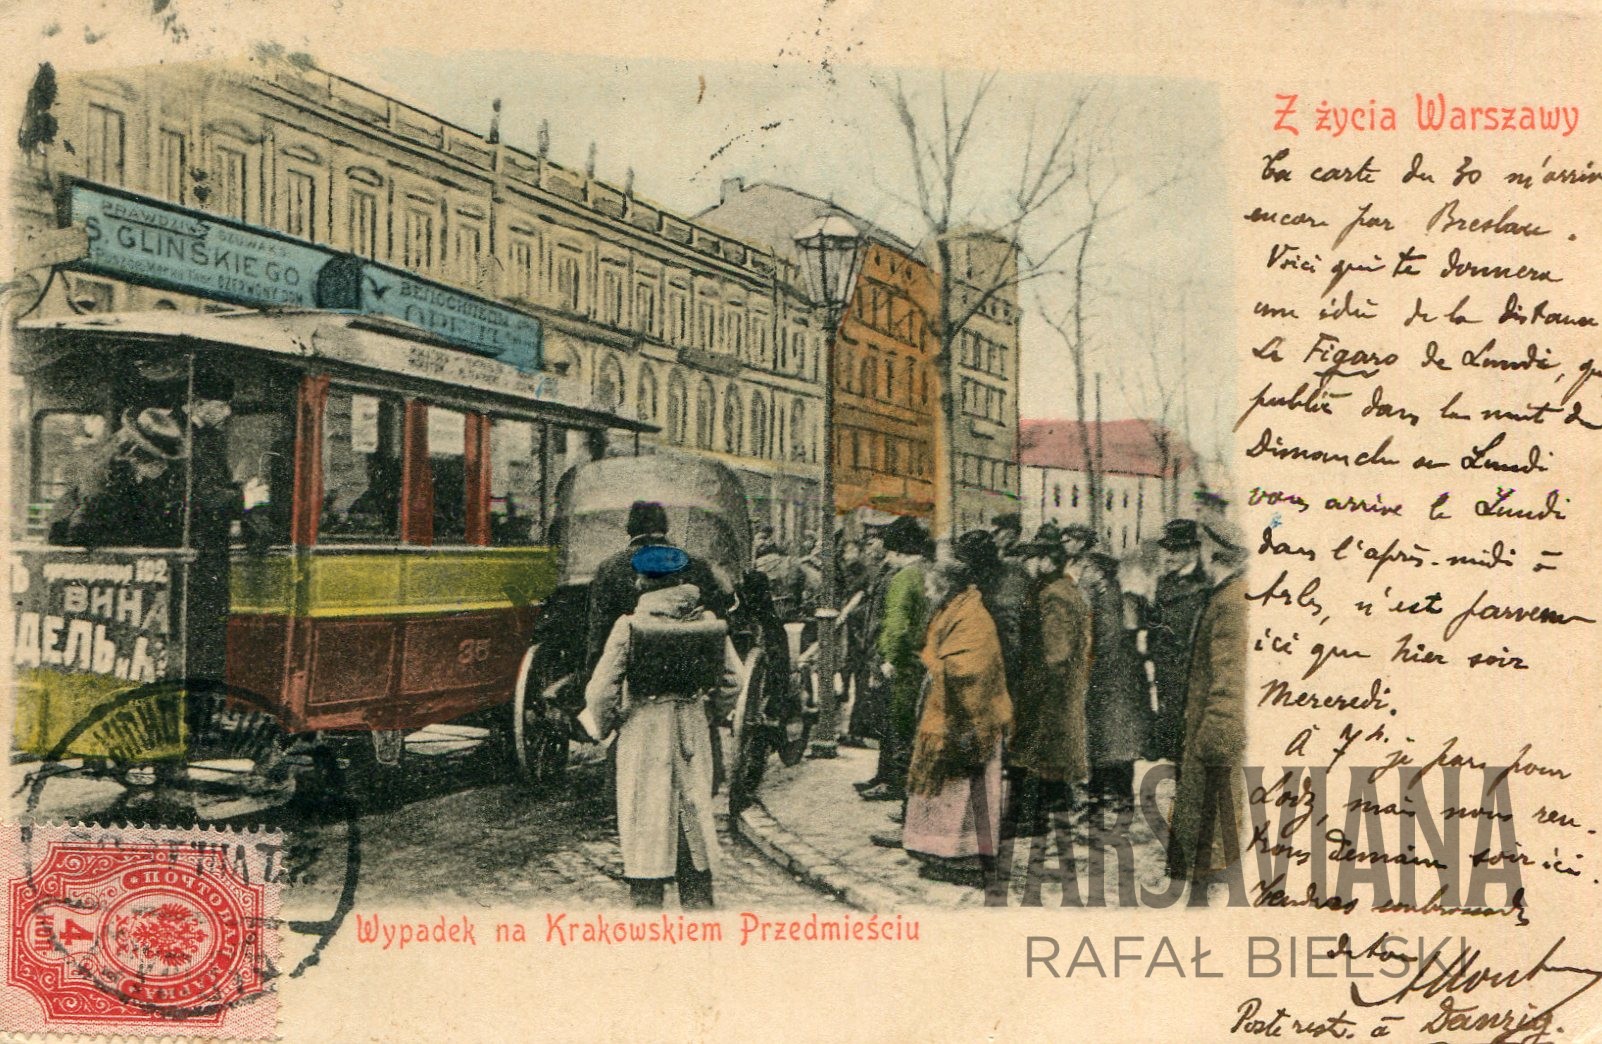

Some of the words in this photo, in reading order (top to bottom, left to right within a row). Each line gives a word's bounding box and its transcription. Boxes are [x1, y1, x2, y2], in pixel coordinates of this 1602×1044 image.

[1273, 93, 1300, 136] Z
[1315, 100, 1397, 137] życia
[1415, 92, 1579, 137] Warszawy
[1391, 633, 1448, 665] hier
[1468, 646, 1529, 669] soir
[59, 918, 94, 946] 4
[356, 913, 477, 950] Wypadek
[495, 922, 527, 943] na
[546, 913, 723, 946] Krakowskiem
[740, 912, 922, 947] Przedmieściu
